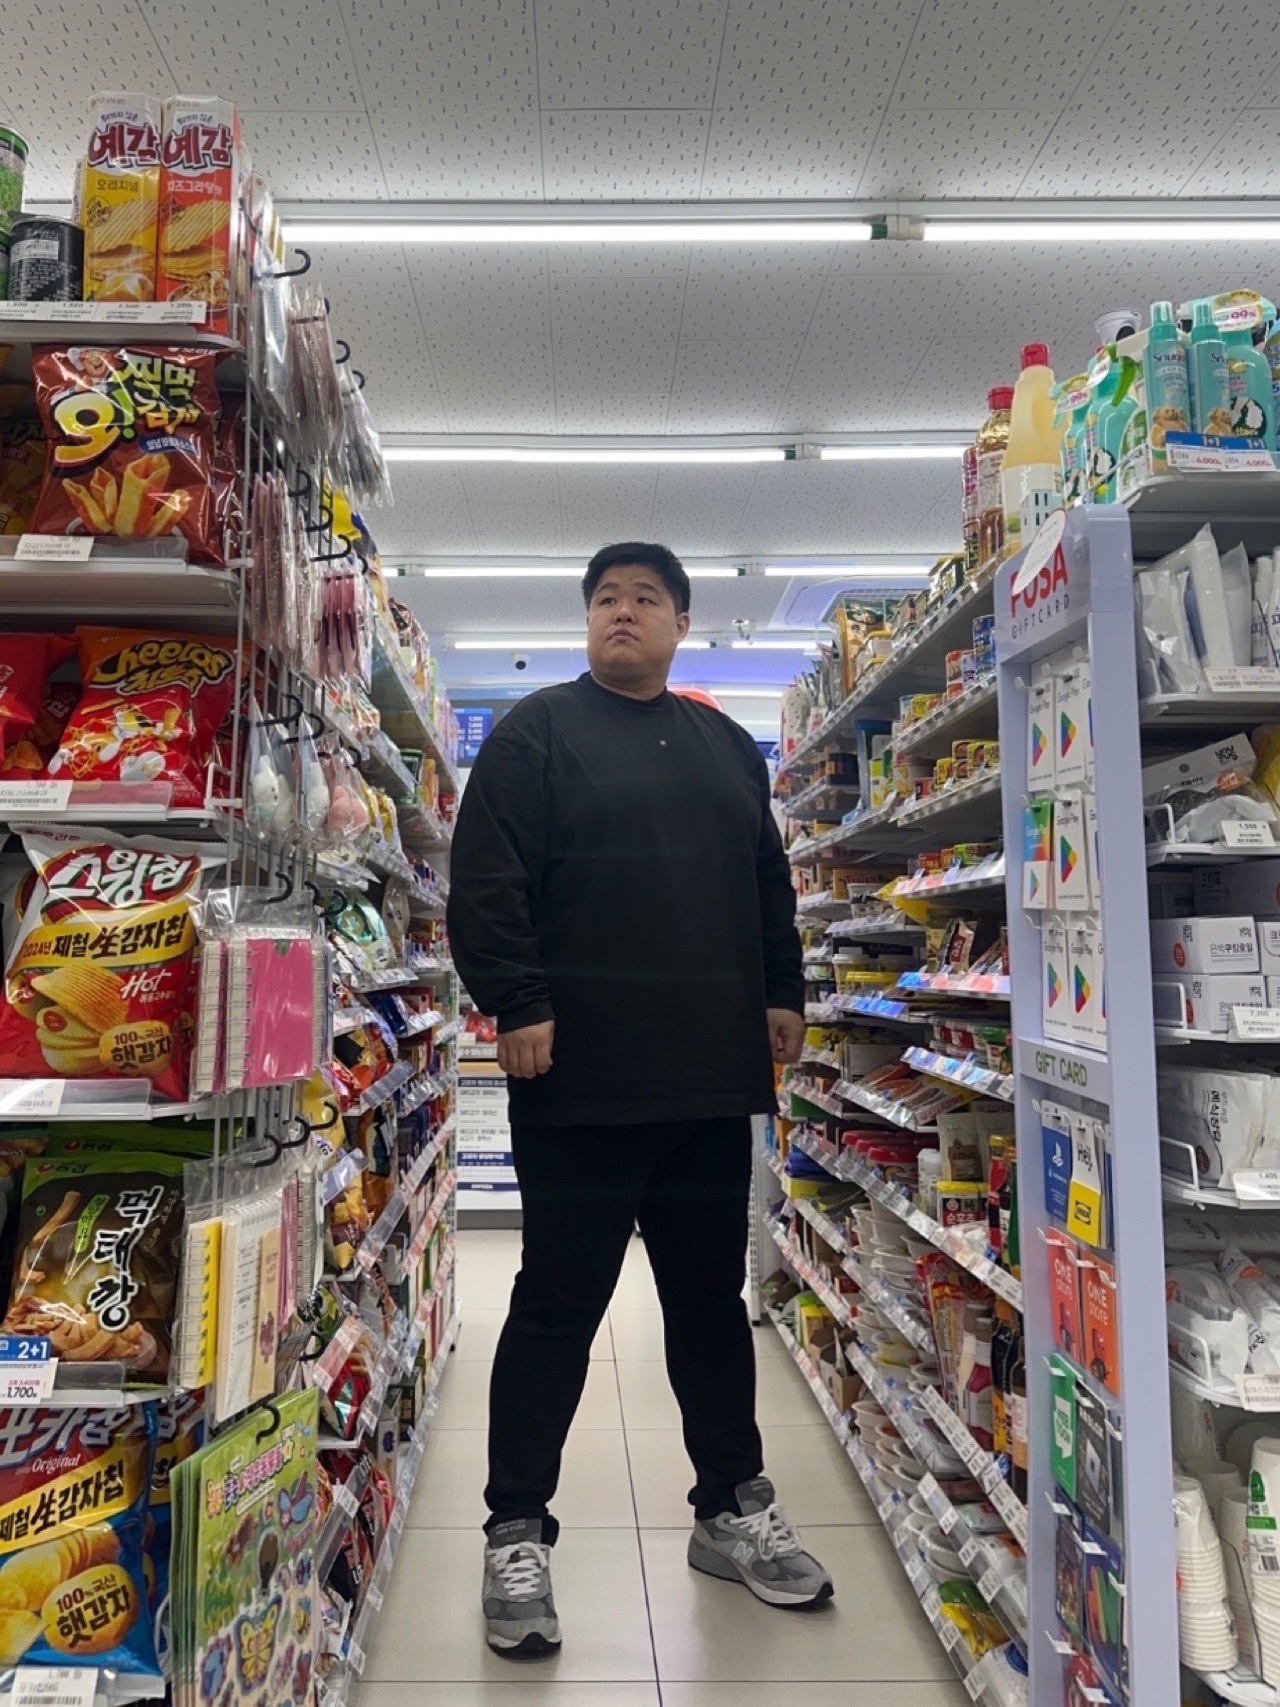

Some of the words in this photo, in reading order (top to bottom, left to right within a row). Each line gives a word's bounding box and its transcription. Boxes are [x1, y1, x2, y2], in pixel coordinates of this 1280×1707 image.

[89, 123, 160, 168] 예감
[162, 123, 233, 169] 예감
[97, 179, 139, 191] 오리지널
[1203, 435, 1220, 446] 1+1
[44, 849, 192, 909] 스윙칩
[52, 932, 90, 957] 제철
[120, 968, 172, 999] Hot
[144, 1026, 164, 1039] 국산
[111, 1036, 171, 1071] 햇감자
[1035, 1050, 1056, 1077] GIFT
[1060, 1057, 1087, 1088] CARD
[88, 1186, 164, 1332] 먹태깡
[17, 1341, 48, 1359] 2+1
[32, 1453, 82, 1474] Original
[91, 1573, 117, 1593] 국산
[57, 1585, 130, 1649] 햇감자
